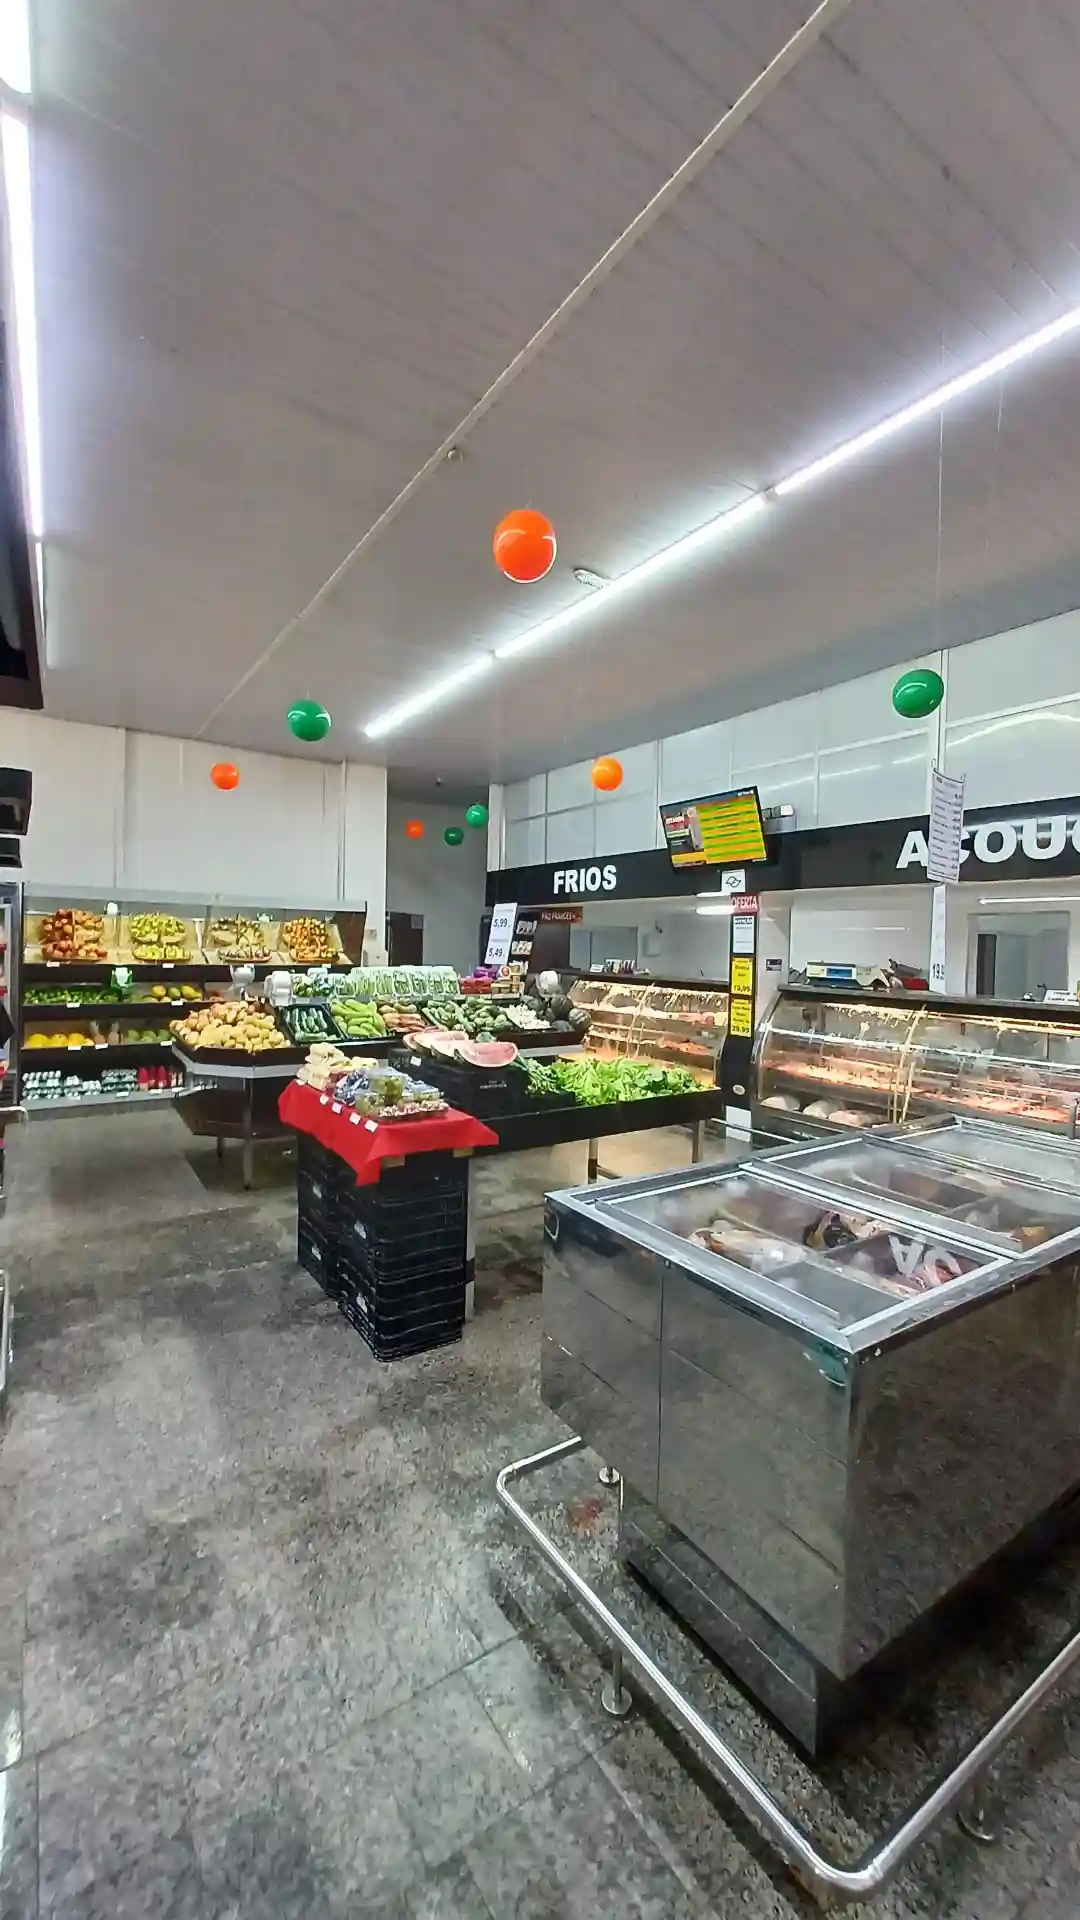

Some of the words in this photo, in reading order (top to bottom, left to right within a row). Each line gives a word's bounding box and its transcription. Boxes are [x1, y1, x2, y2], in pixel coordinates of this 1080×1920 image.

[896, 815, 1080, 869] AOU
[553, 864, 617, 894] FRIOS
[731, 895, 757, 909] OFERTA
[493, 918, 508, 929] 5,99
[488, 948, 503, 958] 5,49
